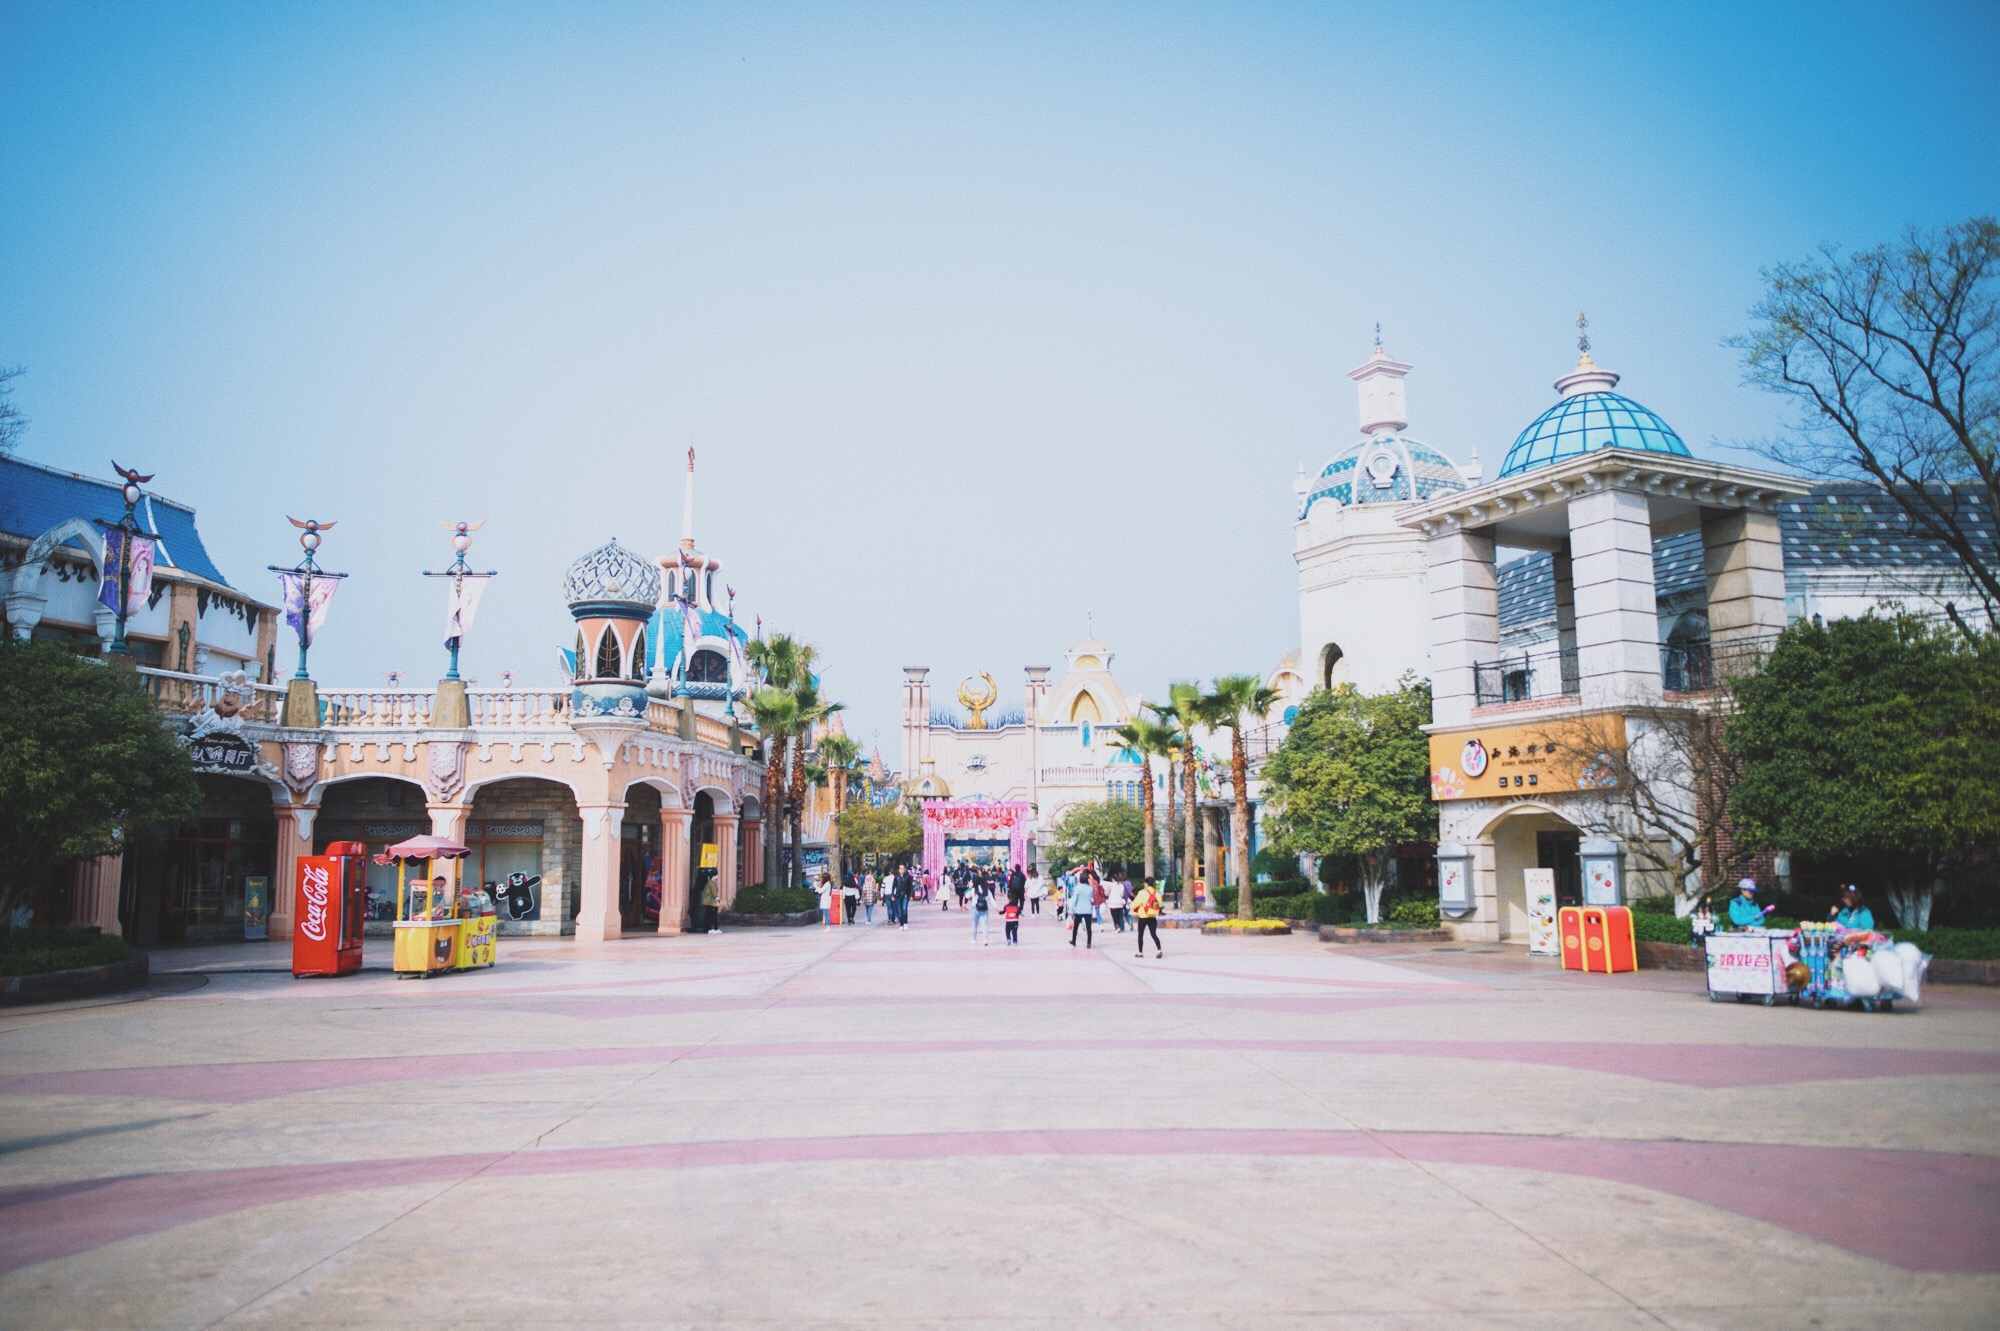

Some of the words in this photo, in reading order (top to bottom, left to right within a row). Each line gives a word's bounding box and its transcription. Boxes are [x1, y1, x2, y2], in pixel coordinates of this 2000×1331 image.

[315, 826, 360, 836] UMAMOTO
[369, 825, 421, 836] KUMAMOTO
[490, 825, 543, 836] KUMAMOTO
[301, 863, 329, 941] Coca-Cola
